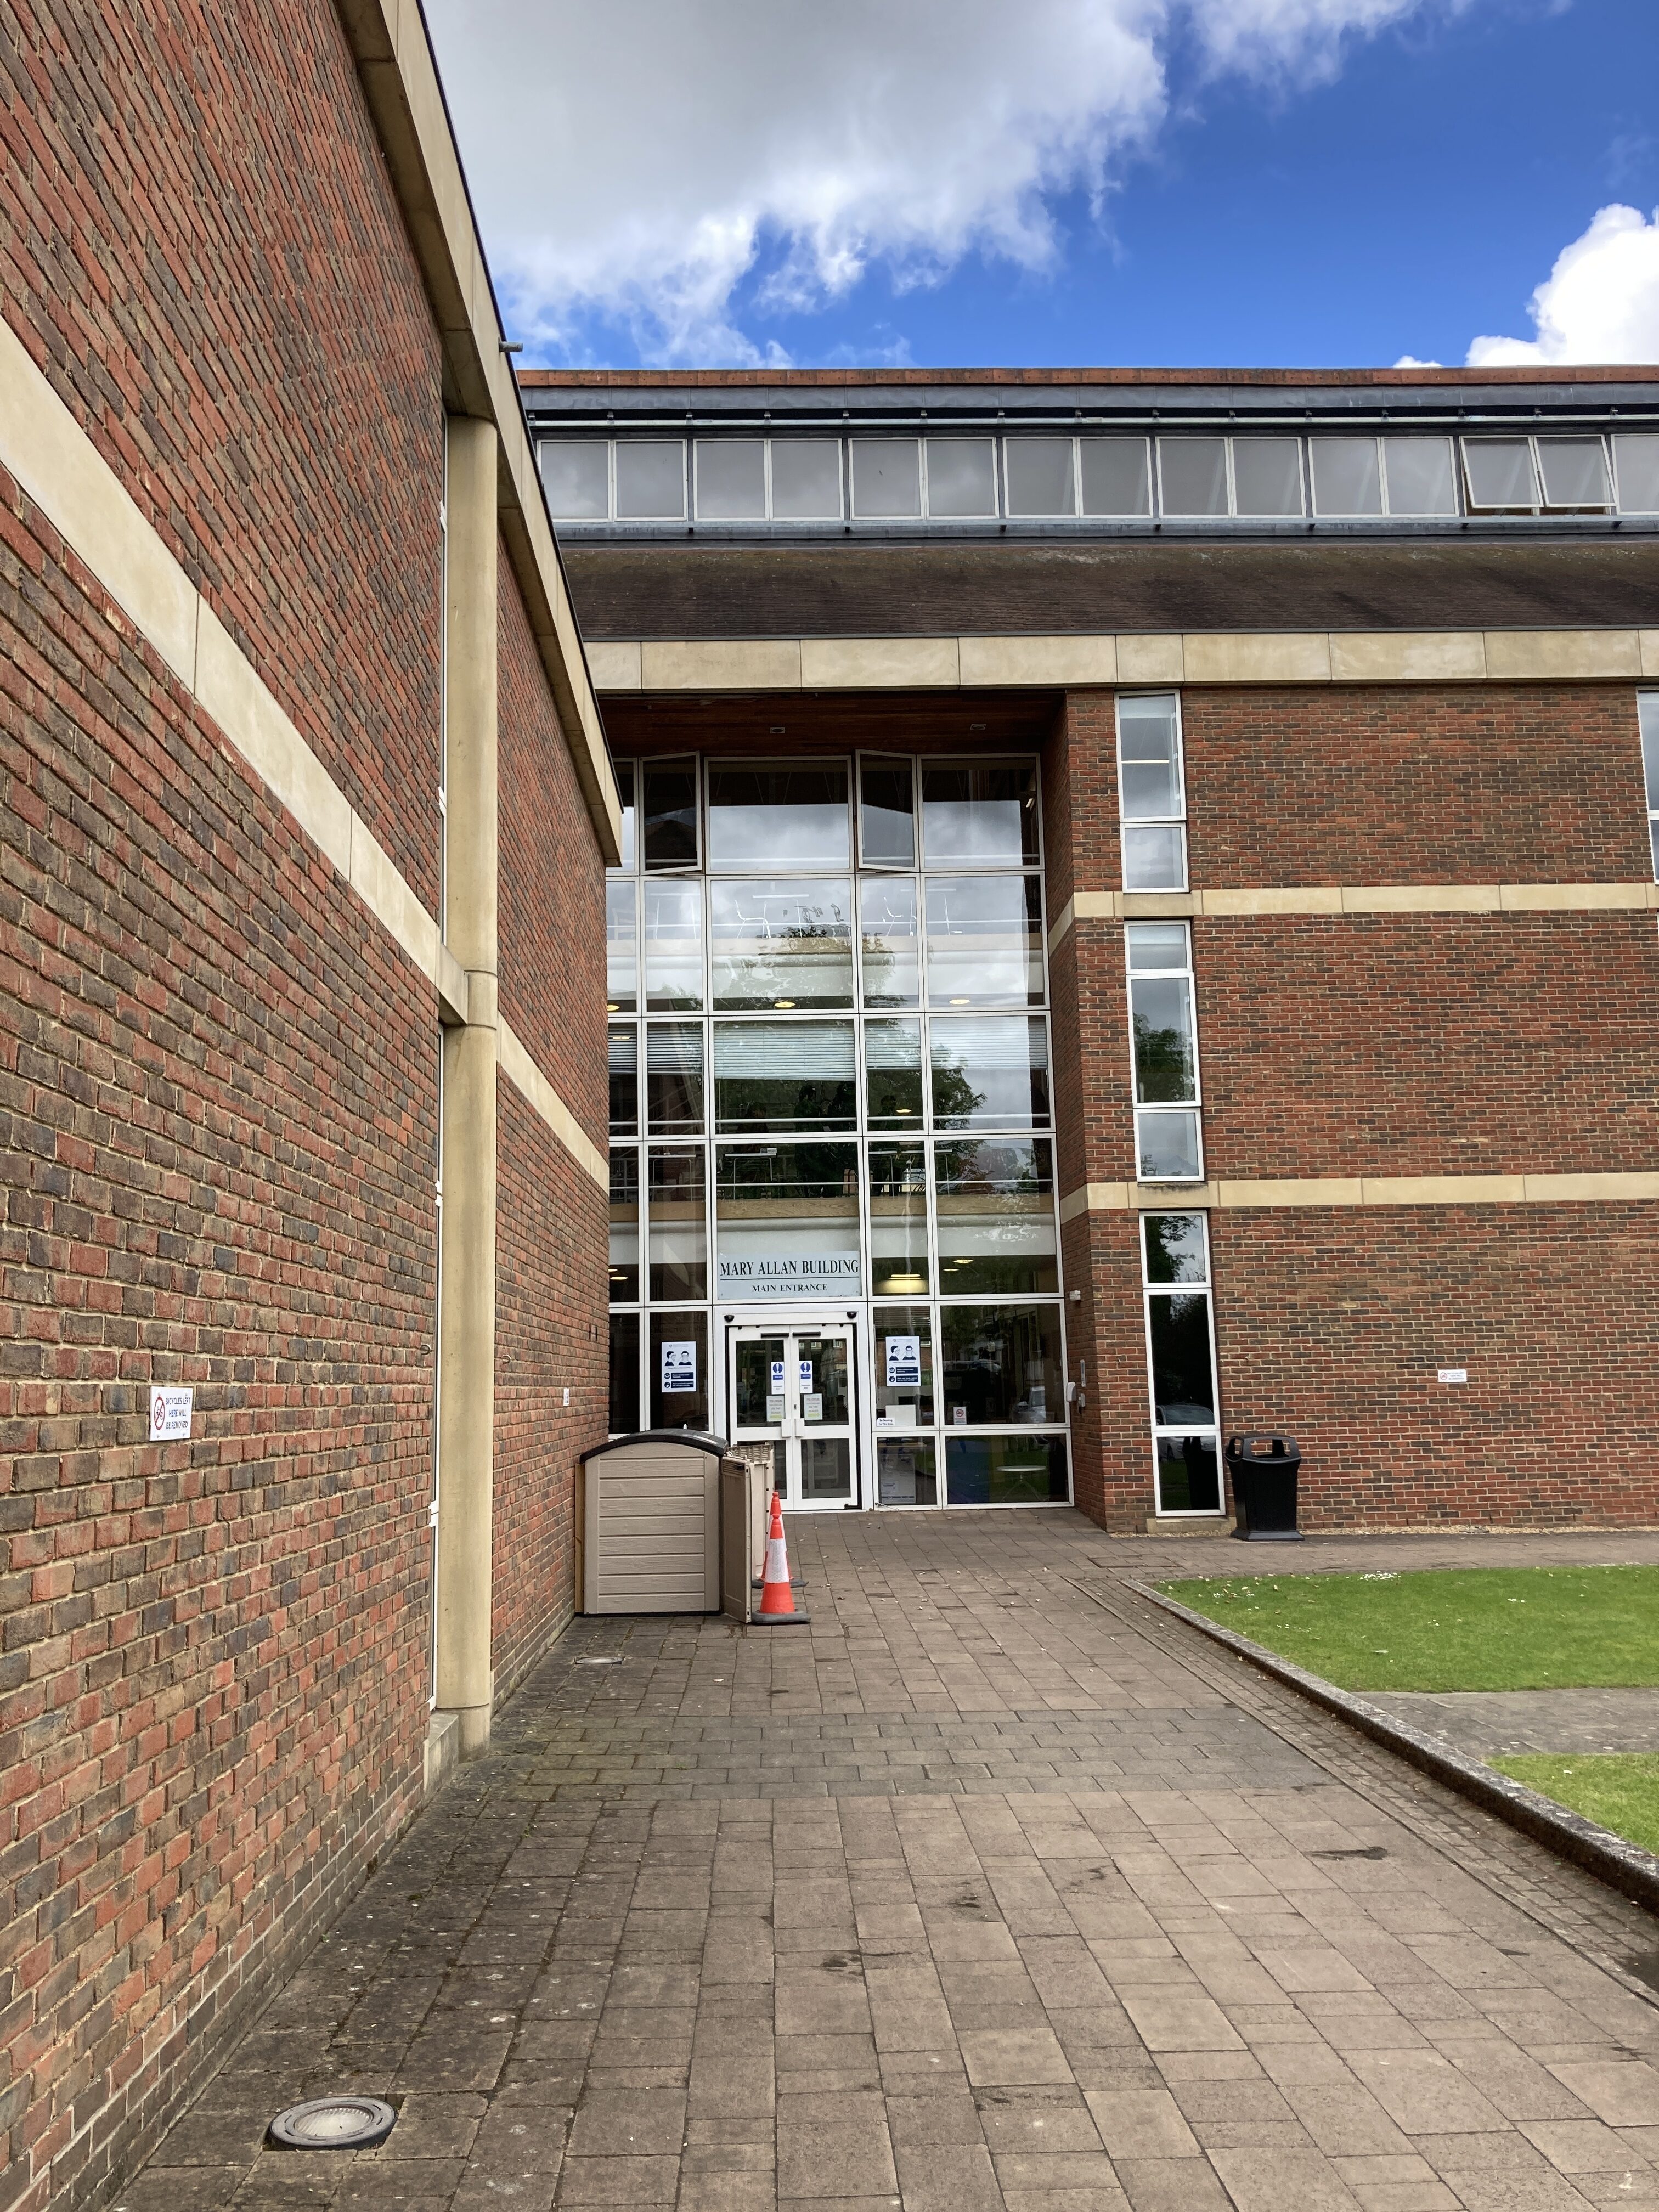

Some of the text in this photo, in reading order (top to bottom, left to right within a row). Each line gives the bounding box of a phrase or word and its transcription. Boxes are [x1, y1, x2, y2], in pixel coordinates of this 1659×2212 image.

[720, 1260, 859, 1276] MARY ALLAN BUILDING
[752, 1284, 777, 1293] MAIN
[168, 1409, 178, 1417] HERE
[171, 1421, 188, 1429] REMOVED
